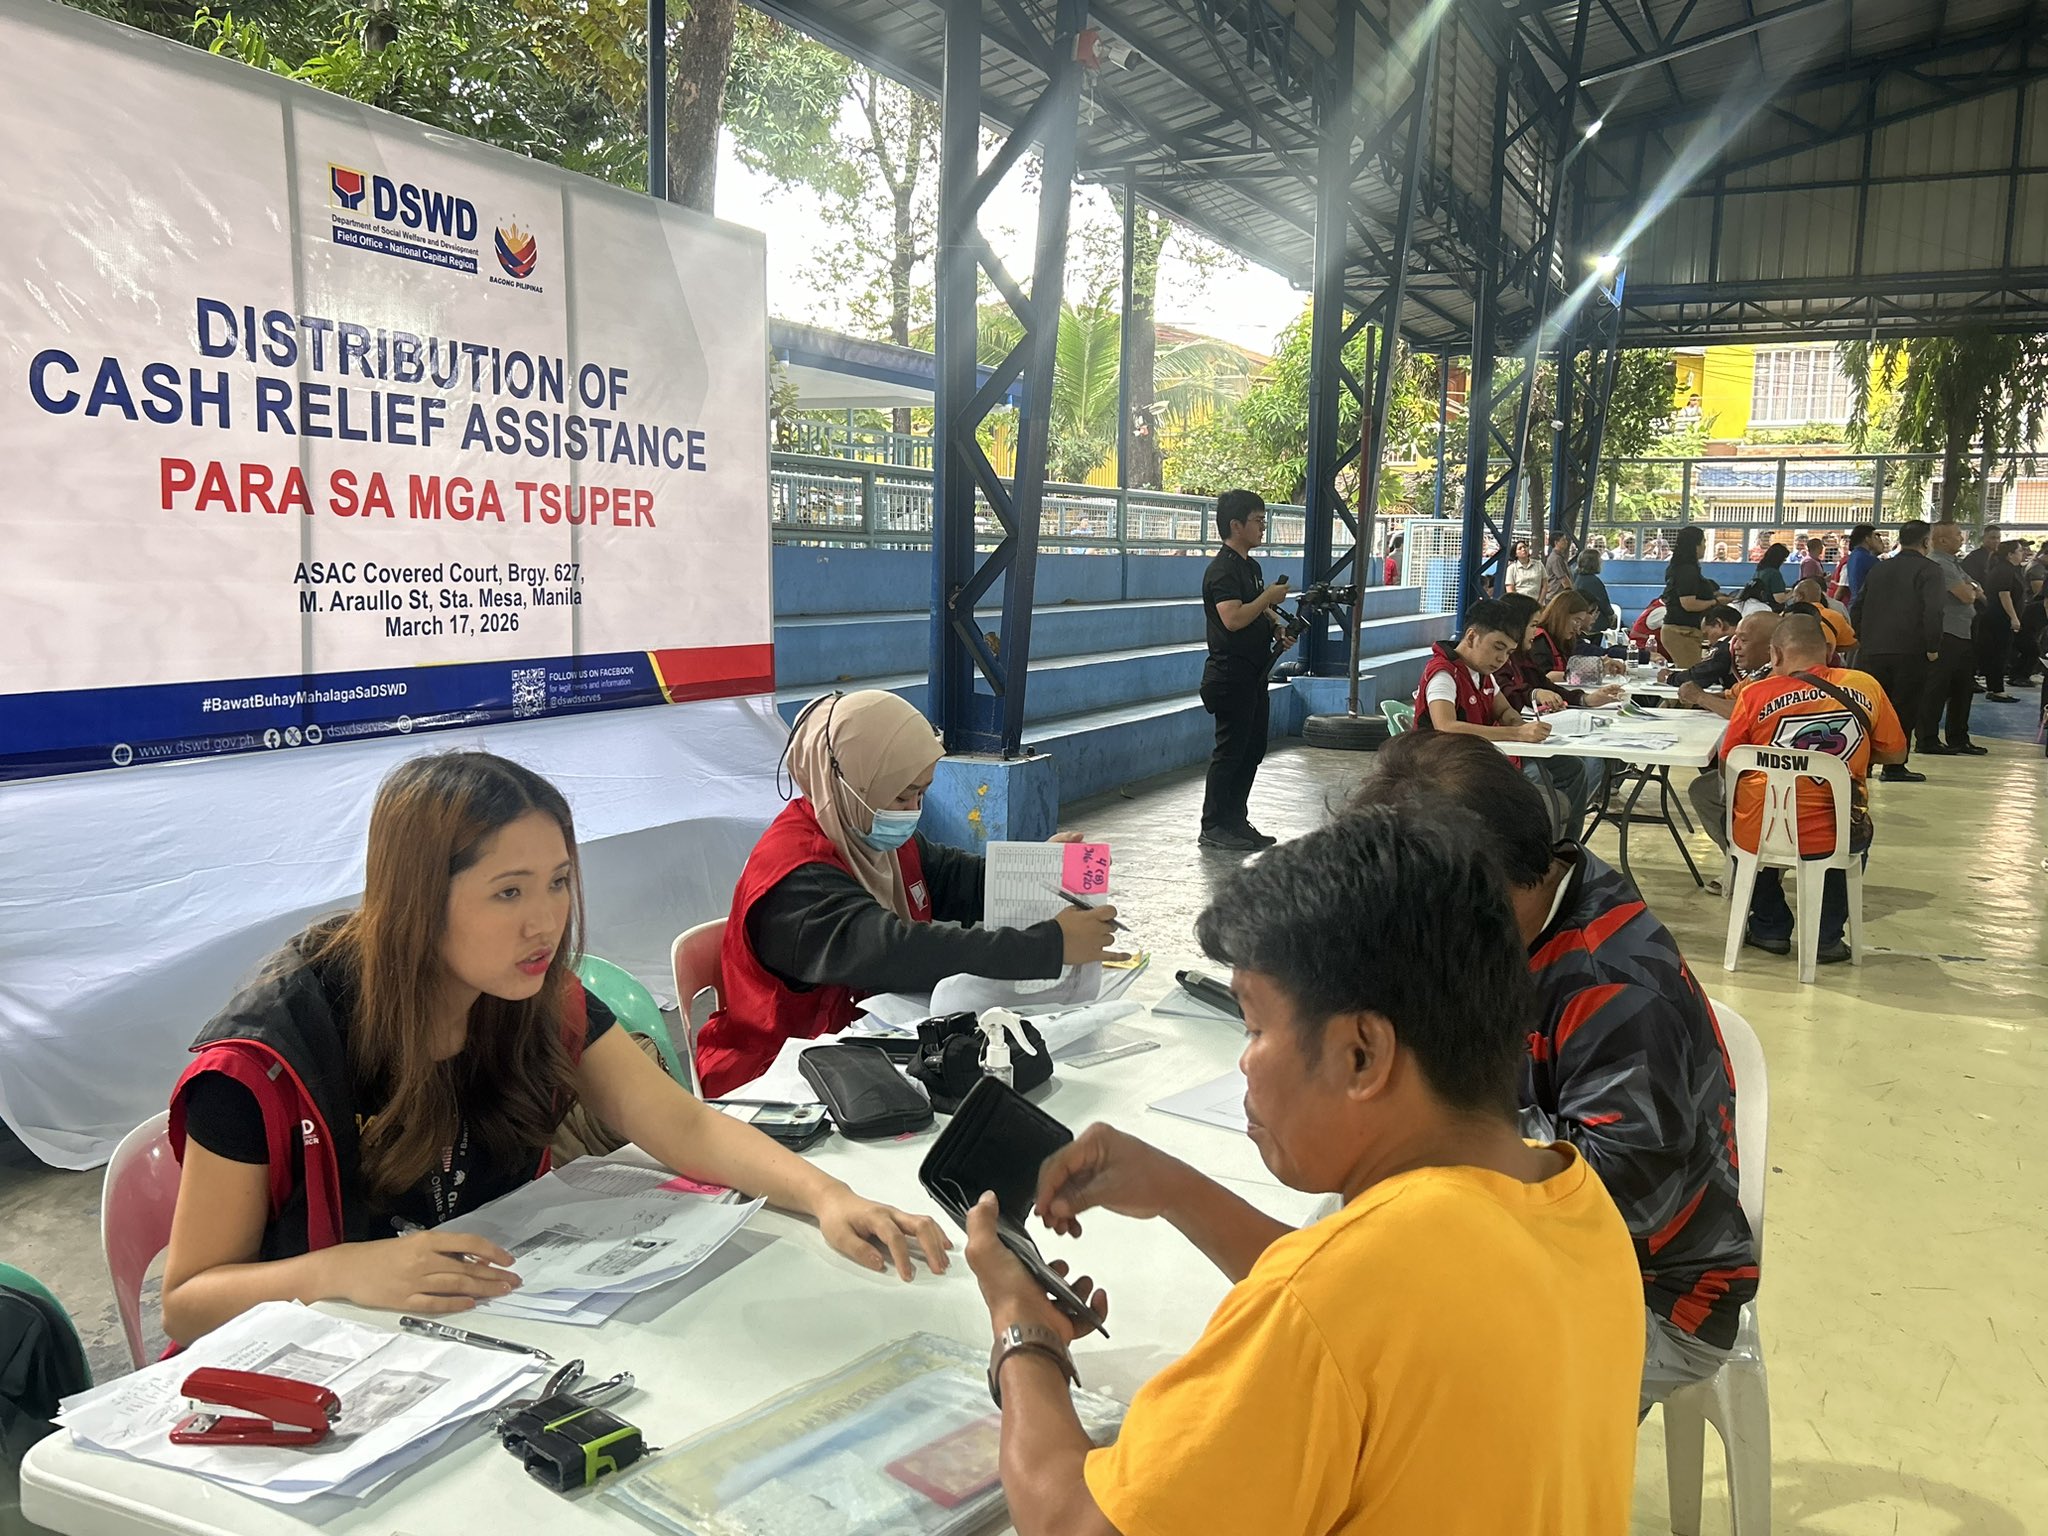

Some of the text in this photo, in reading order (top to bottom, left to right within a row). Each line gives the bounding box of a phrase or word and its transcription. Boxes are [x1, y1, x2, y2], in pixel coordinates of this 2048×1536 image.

[373, 175, 477, 241] DSWD
[332, 214, 479, 256] Department of Social Welfare and Development
[337, 230, 358, 244] Field
[359, 235, 384, 249] Office
[389, 242, 421, 258] National
[422, 250, 448, 264] Capital
[449, 256, 475, 270] Region
[489, 276, 543, 293] BAGONG PILIPINAS
[197, 297, 628, 411] DISTRIBUTION OF
[29, 349, 706, 472] CASH RELIEF ASSISTANCE
[161, 457, 656, 528] PARA SA MGA TSUPER
[293, 562, 584, 587] ASAC Covered Court, Brgy. 627,
[299, 587, 582, 613] M. Araullo St, Sta. Mesa, Manila
[385, 612, 519, 637] March 17, 2026
[549, 666, 635, 681] FOLLOW US ON FACEBOOK
[589, 680, 600, 689] and
[203, 682, 407, 713] #BawatBuhayMahalagaSaDSWD
[1759, 688, 1827, 721] SAMPALOC
[1756, 751, 1809, 771] MDSW
